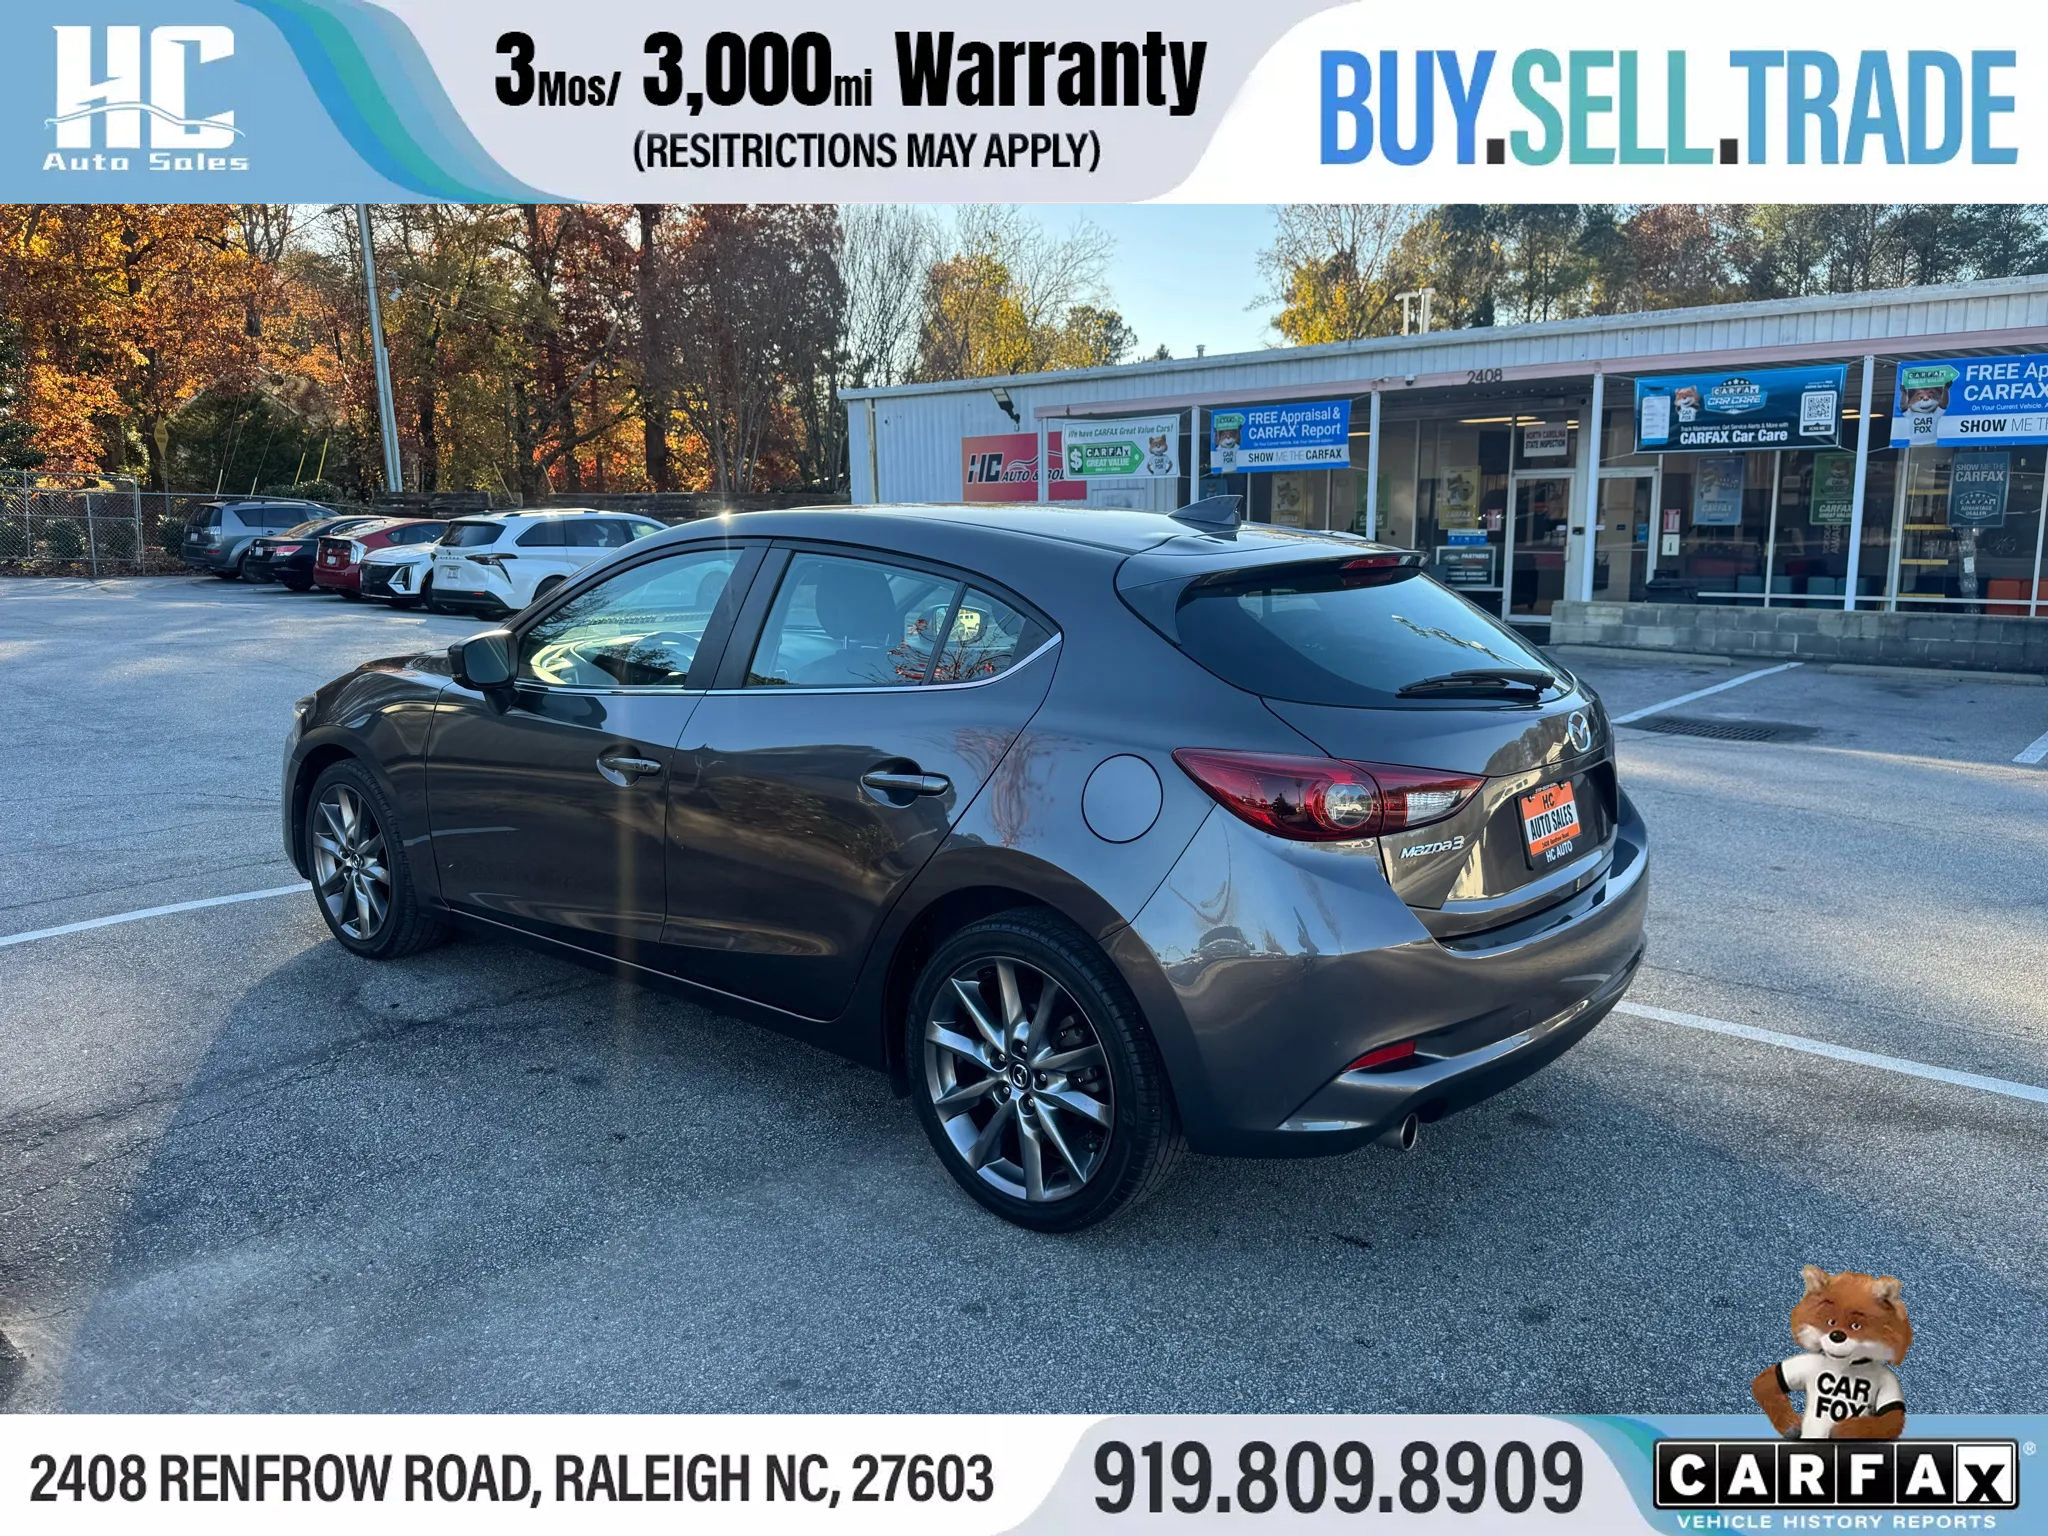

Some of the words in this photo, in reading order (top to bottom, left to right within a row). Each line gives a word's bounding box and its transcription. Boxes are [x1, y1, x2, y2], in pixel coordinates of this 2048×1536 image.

[1467, 368, 1503, 385] 2408
[1966, 363, 2021, 382] FREE
[1714, 385, 1760, 395] CARFAX
[1963, 382, 2048, 402] CARFAX
[1981, 403, 1995, 411] Your
[1996, 402, 2018, 411] Current
[1249, 411, 1278, 425] FREE
[1280, 407, 1331, 426] Appraisal
[1333, 406, 1341, 420] &
[1913, 417, 1933, 426] CAR
[1079, 429, 1093, 437] have
[1094, 428, 1118, 437] CARFAX
[1120, 427, 1136, 435] Great
[1138, 426, 1154, 434] Value
[1156, 424, 1174, 433] Cars!
[1248, 425, 1296, 440] CARFAX
[1302, 423, 1341, 438] Report
[1913, 425, 1932, 434] FOX
[1960, 418, 2007, 433] SHOW
[2011, 417, 2033, 432] ME
[1680, 430, 1729, 444] CARFAX
[1732, 430, 1755, 443] Car
[1757, 429, 1788, 442] Care
[1086, 446, 1131, 457] CARFAX
[1248, 452, 1274, 463] SHOW
[1305, 448, 1342, 461] CARFAX
[967, 453, 1003, 483] HC
[1109, 458, 1130, 466] VALUE
[1001, 470, 1030, 482] AUTO
[1955, 471, 2005, 482] CARFAX
[1819, 504, 1853, 512] CARFAX
[1542, 793, 1555, 809] HC
[1530, 814, 1552, 840] AUTO
[1551, 804, 1574, 831] SALES
[1545, 848, 1556, 863] HC
[1556, 840, 1573, 858] AUTO
